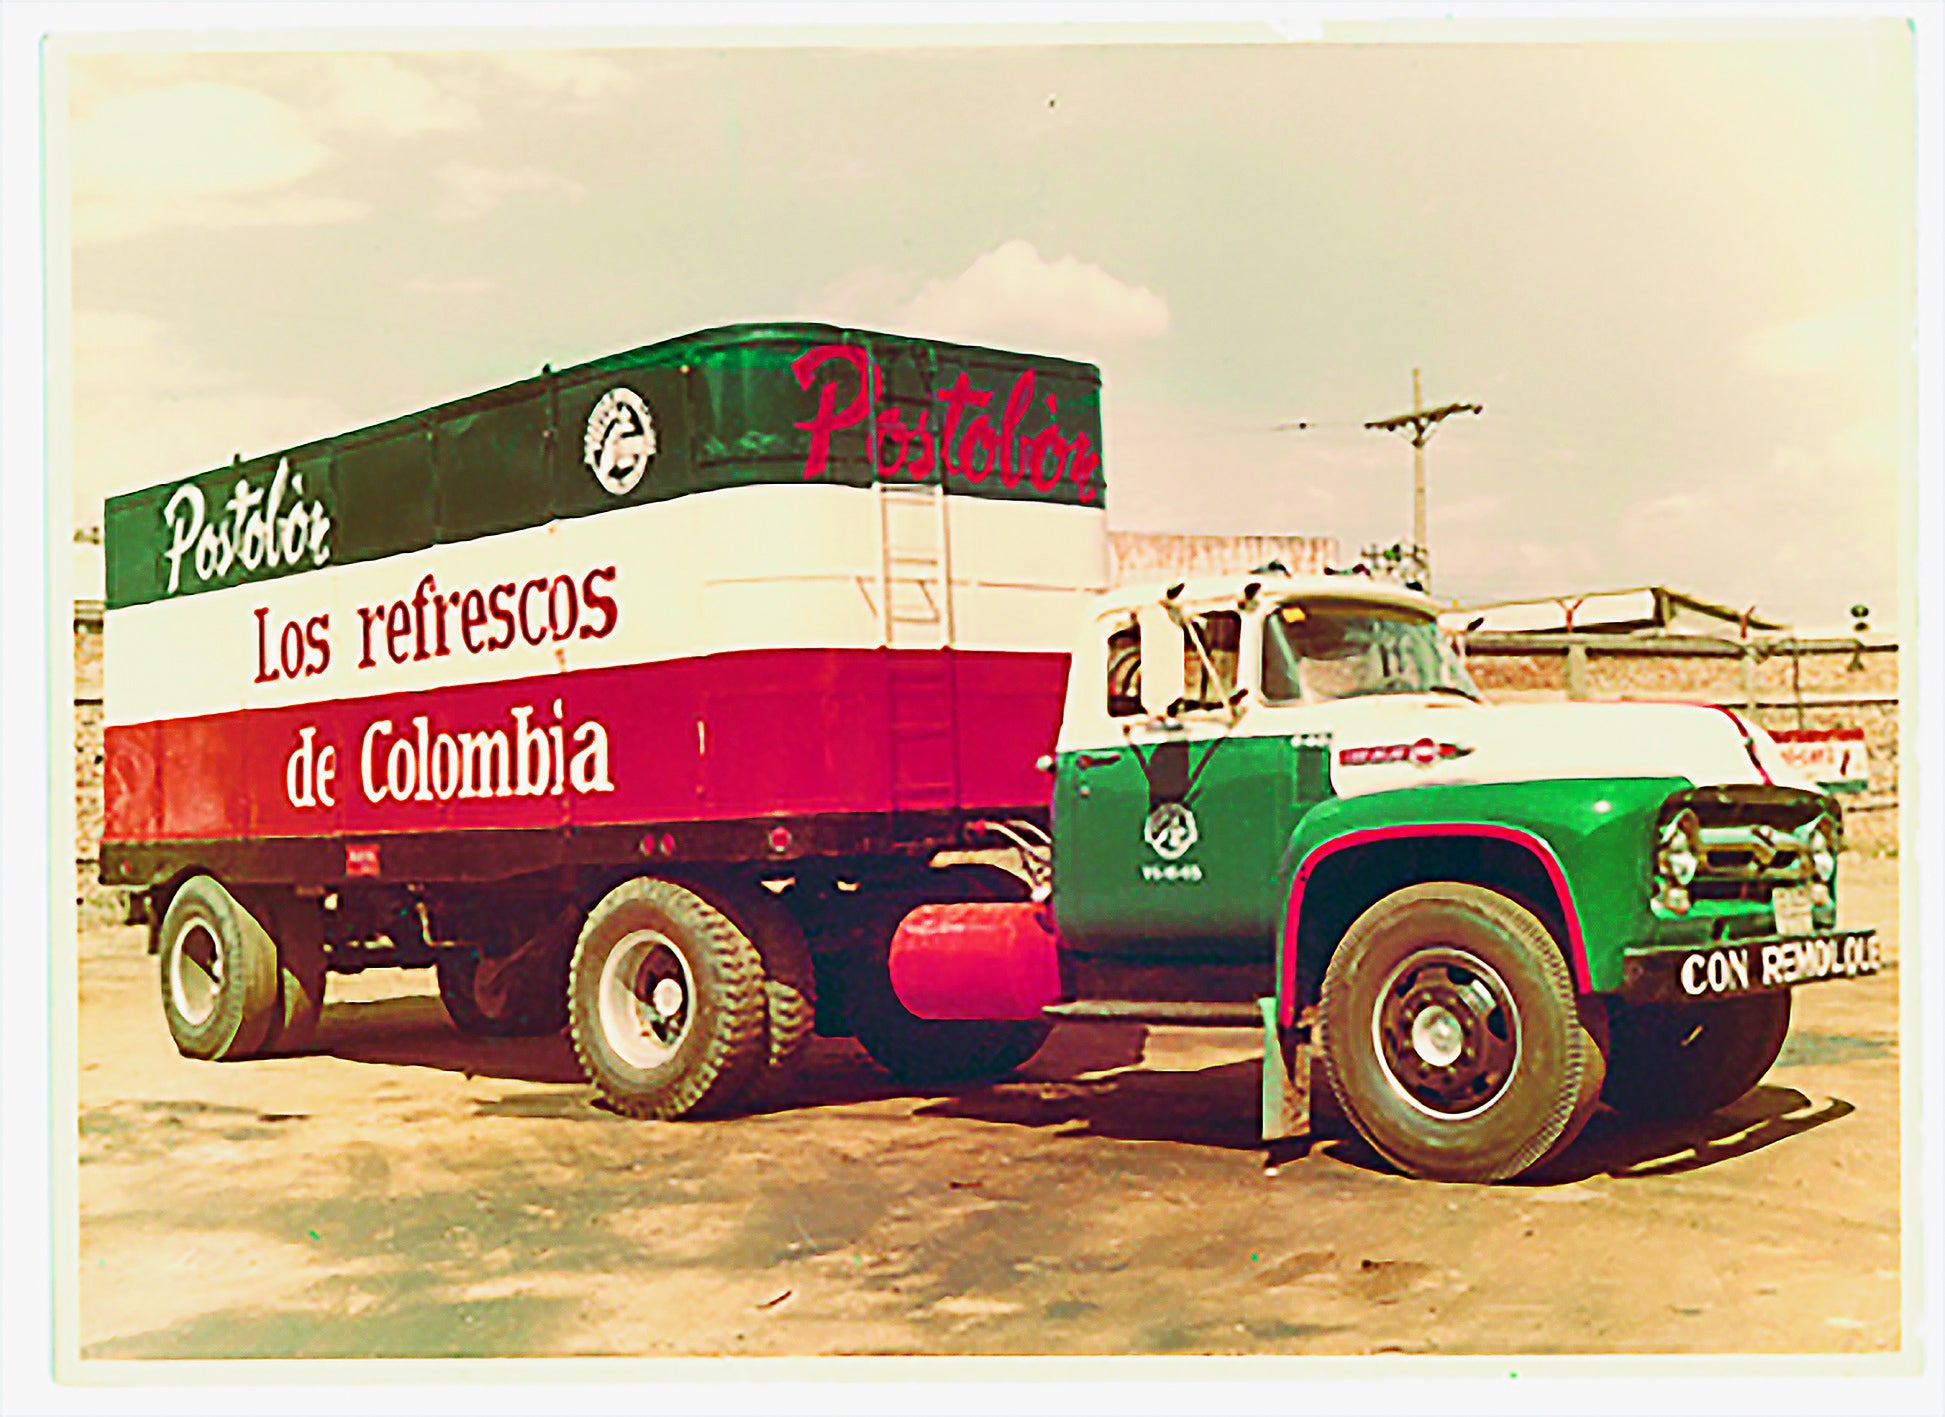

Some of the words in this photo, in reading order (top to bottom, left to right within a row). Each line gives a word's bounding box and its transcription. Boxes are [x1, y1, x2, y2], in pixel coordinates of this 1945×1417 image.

[254, 607, 330, 684] Los
[357, 567, 618, 669] refrescos
[286, 726, 336, 808] de
[360, 699, 615, 804] Colombia
[1681, 949, 1749, 995] CON
[1762, 936, 1881, 986] REMOLQUE
